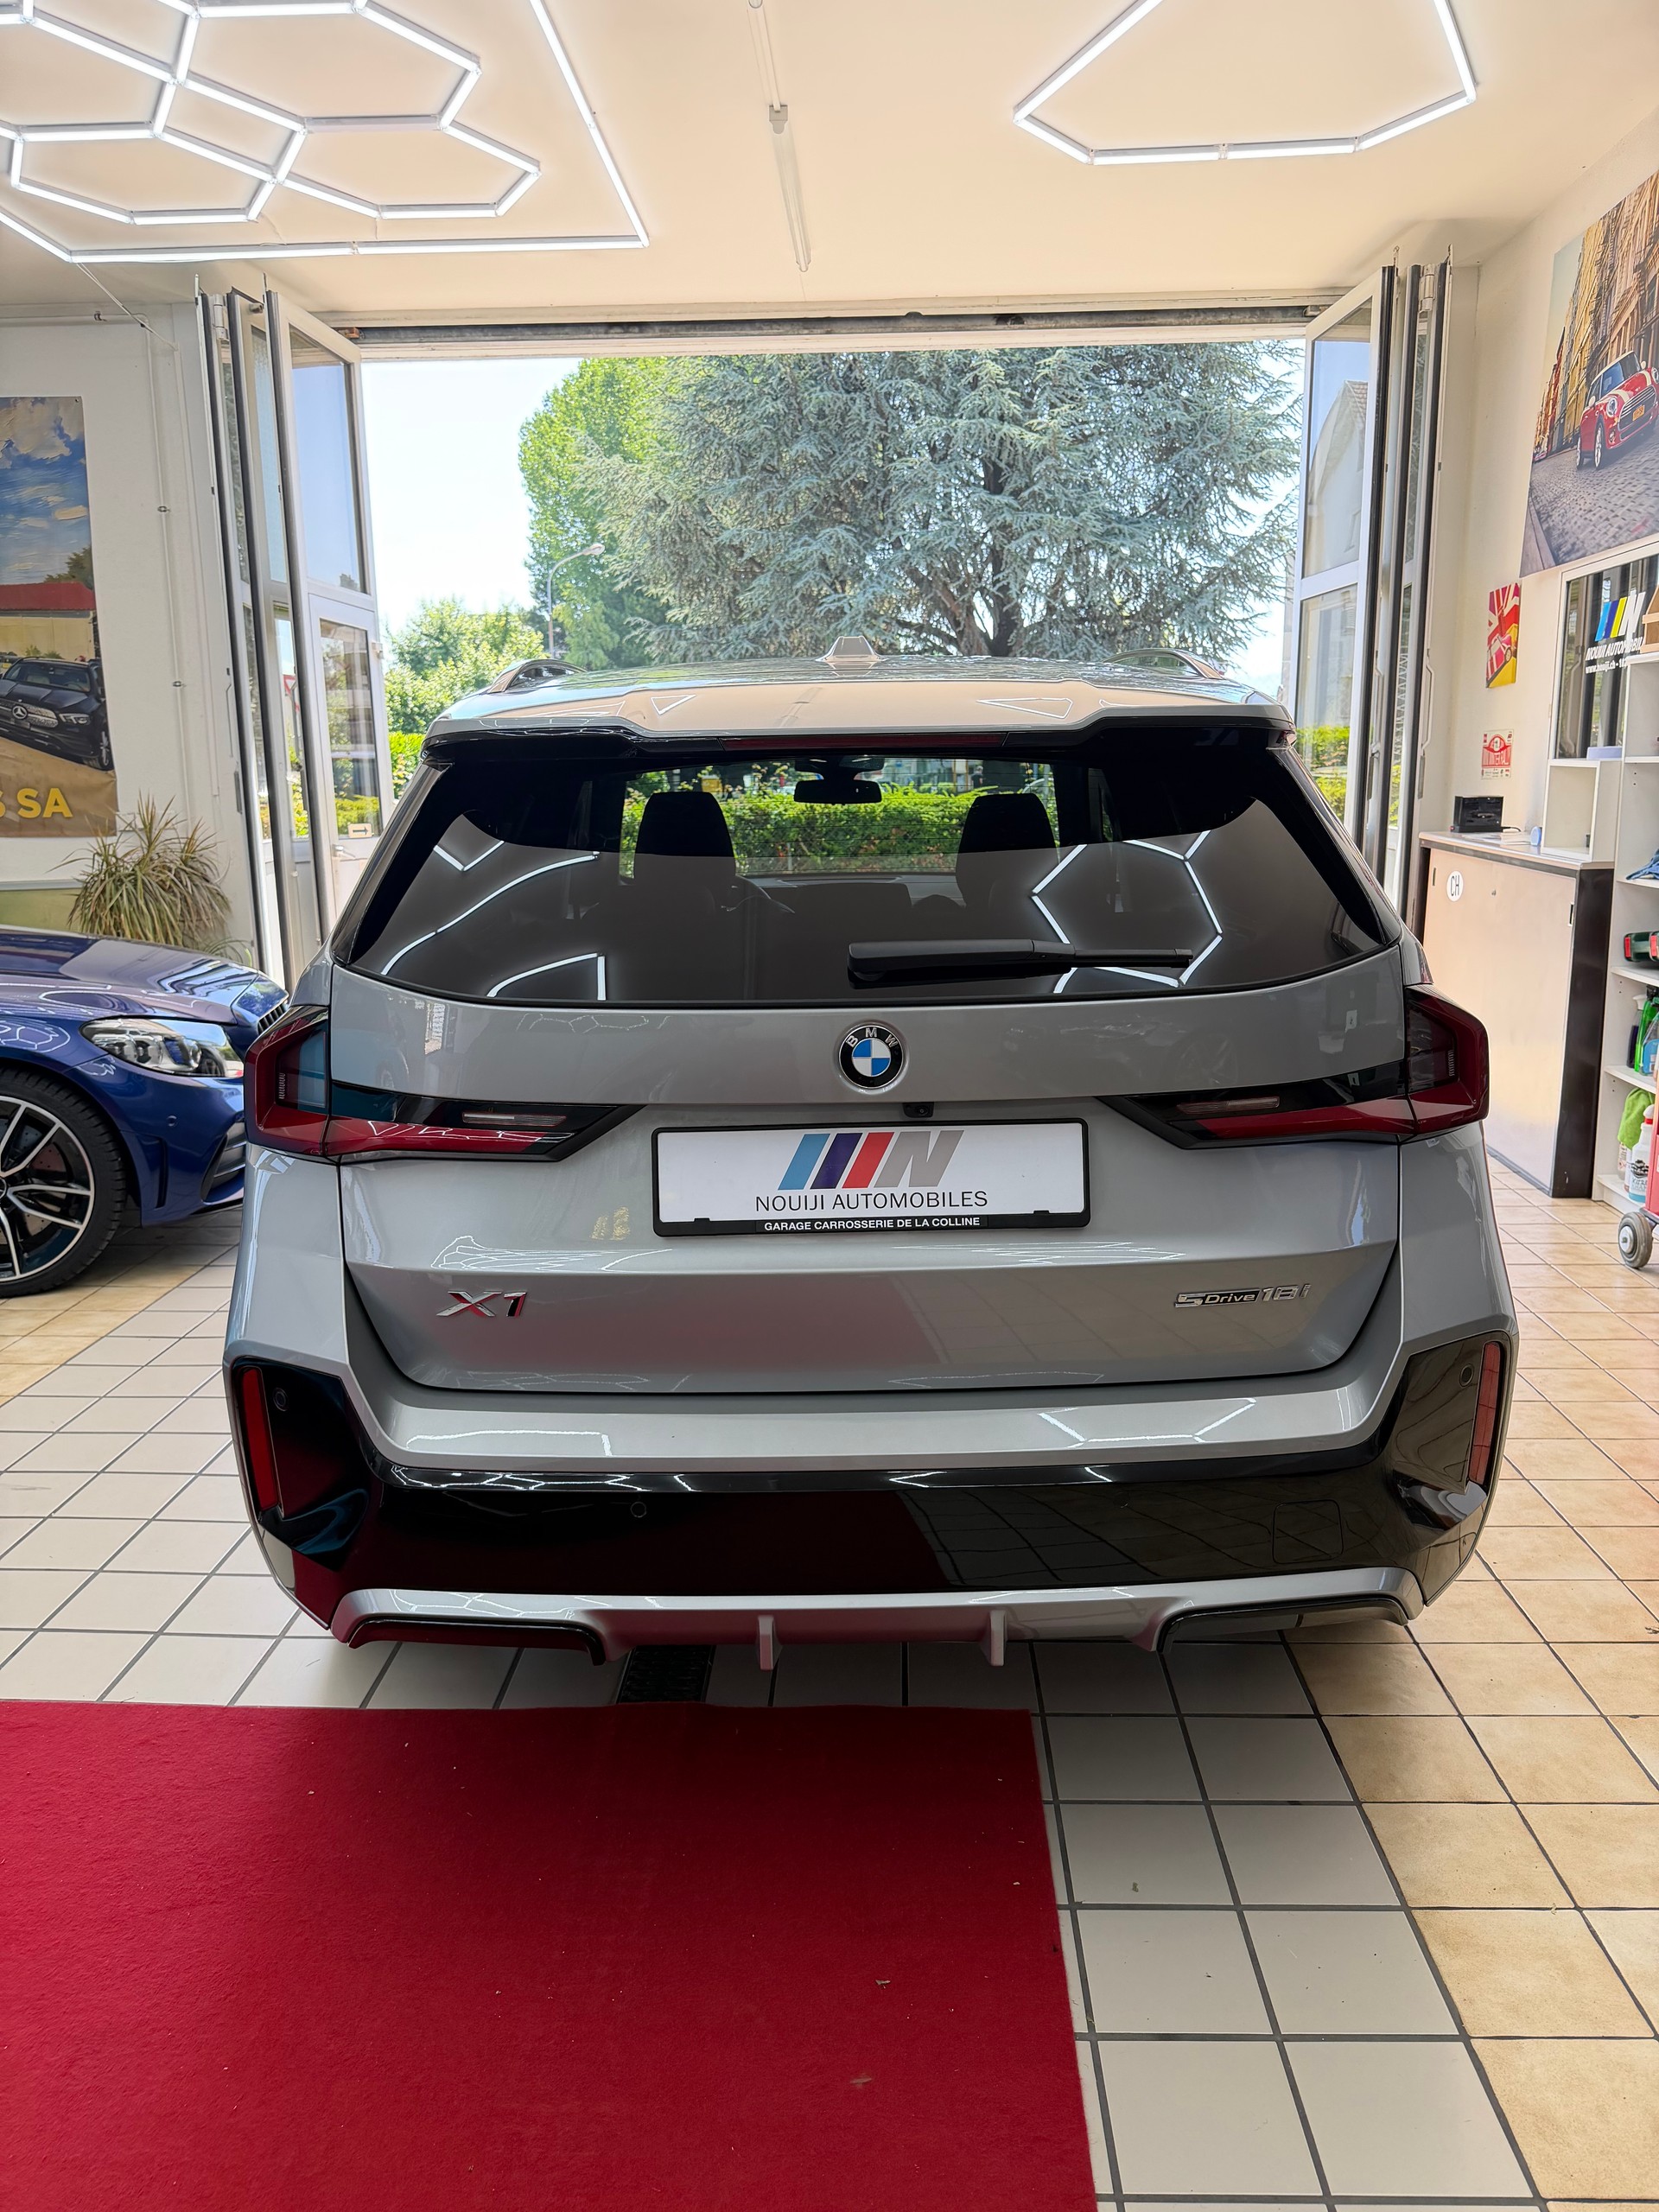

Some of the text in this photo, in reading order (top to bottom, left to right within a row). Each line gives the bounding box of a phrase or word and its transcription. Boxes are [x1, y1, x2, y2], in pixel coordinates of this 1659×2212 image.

[17, 787, 73, 819] SA
[1450, 874, 1460, 897] CH
[846, 1027, 898, 1048] BMW
[755, 1191, 988, 1211] NOUIJI AUTOMOBILES
[764, 1217, 981, 1231] GARAGE CARROSSERIE DE LA COLLINE
[436, 1290, 527, 1318] X1
